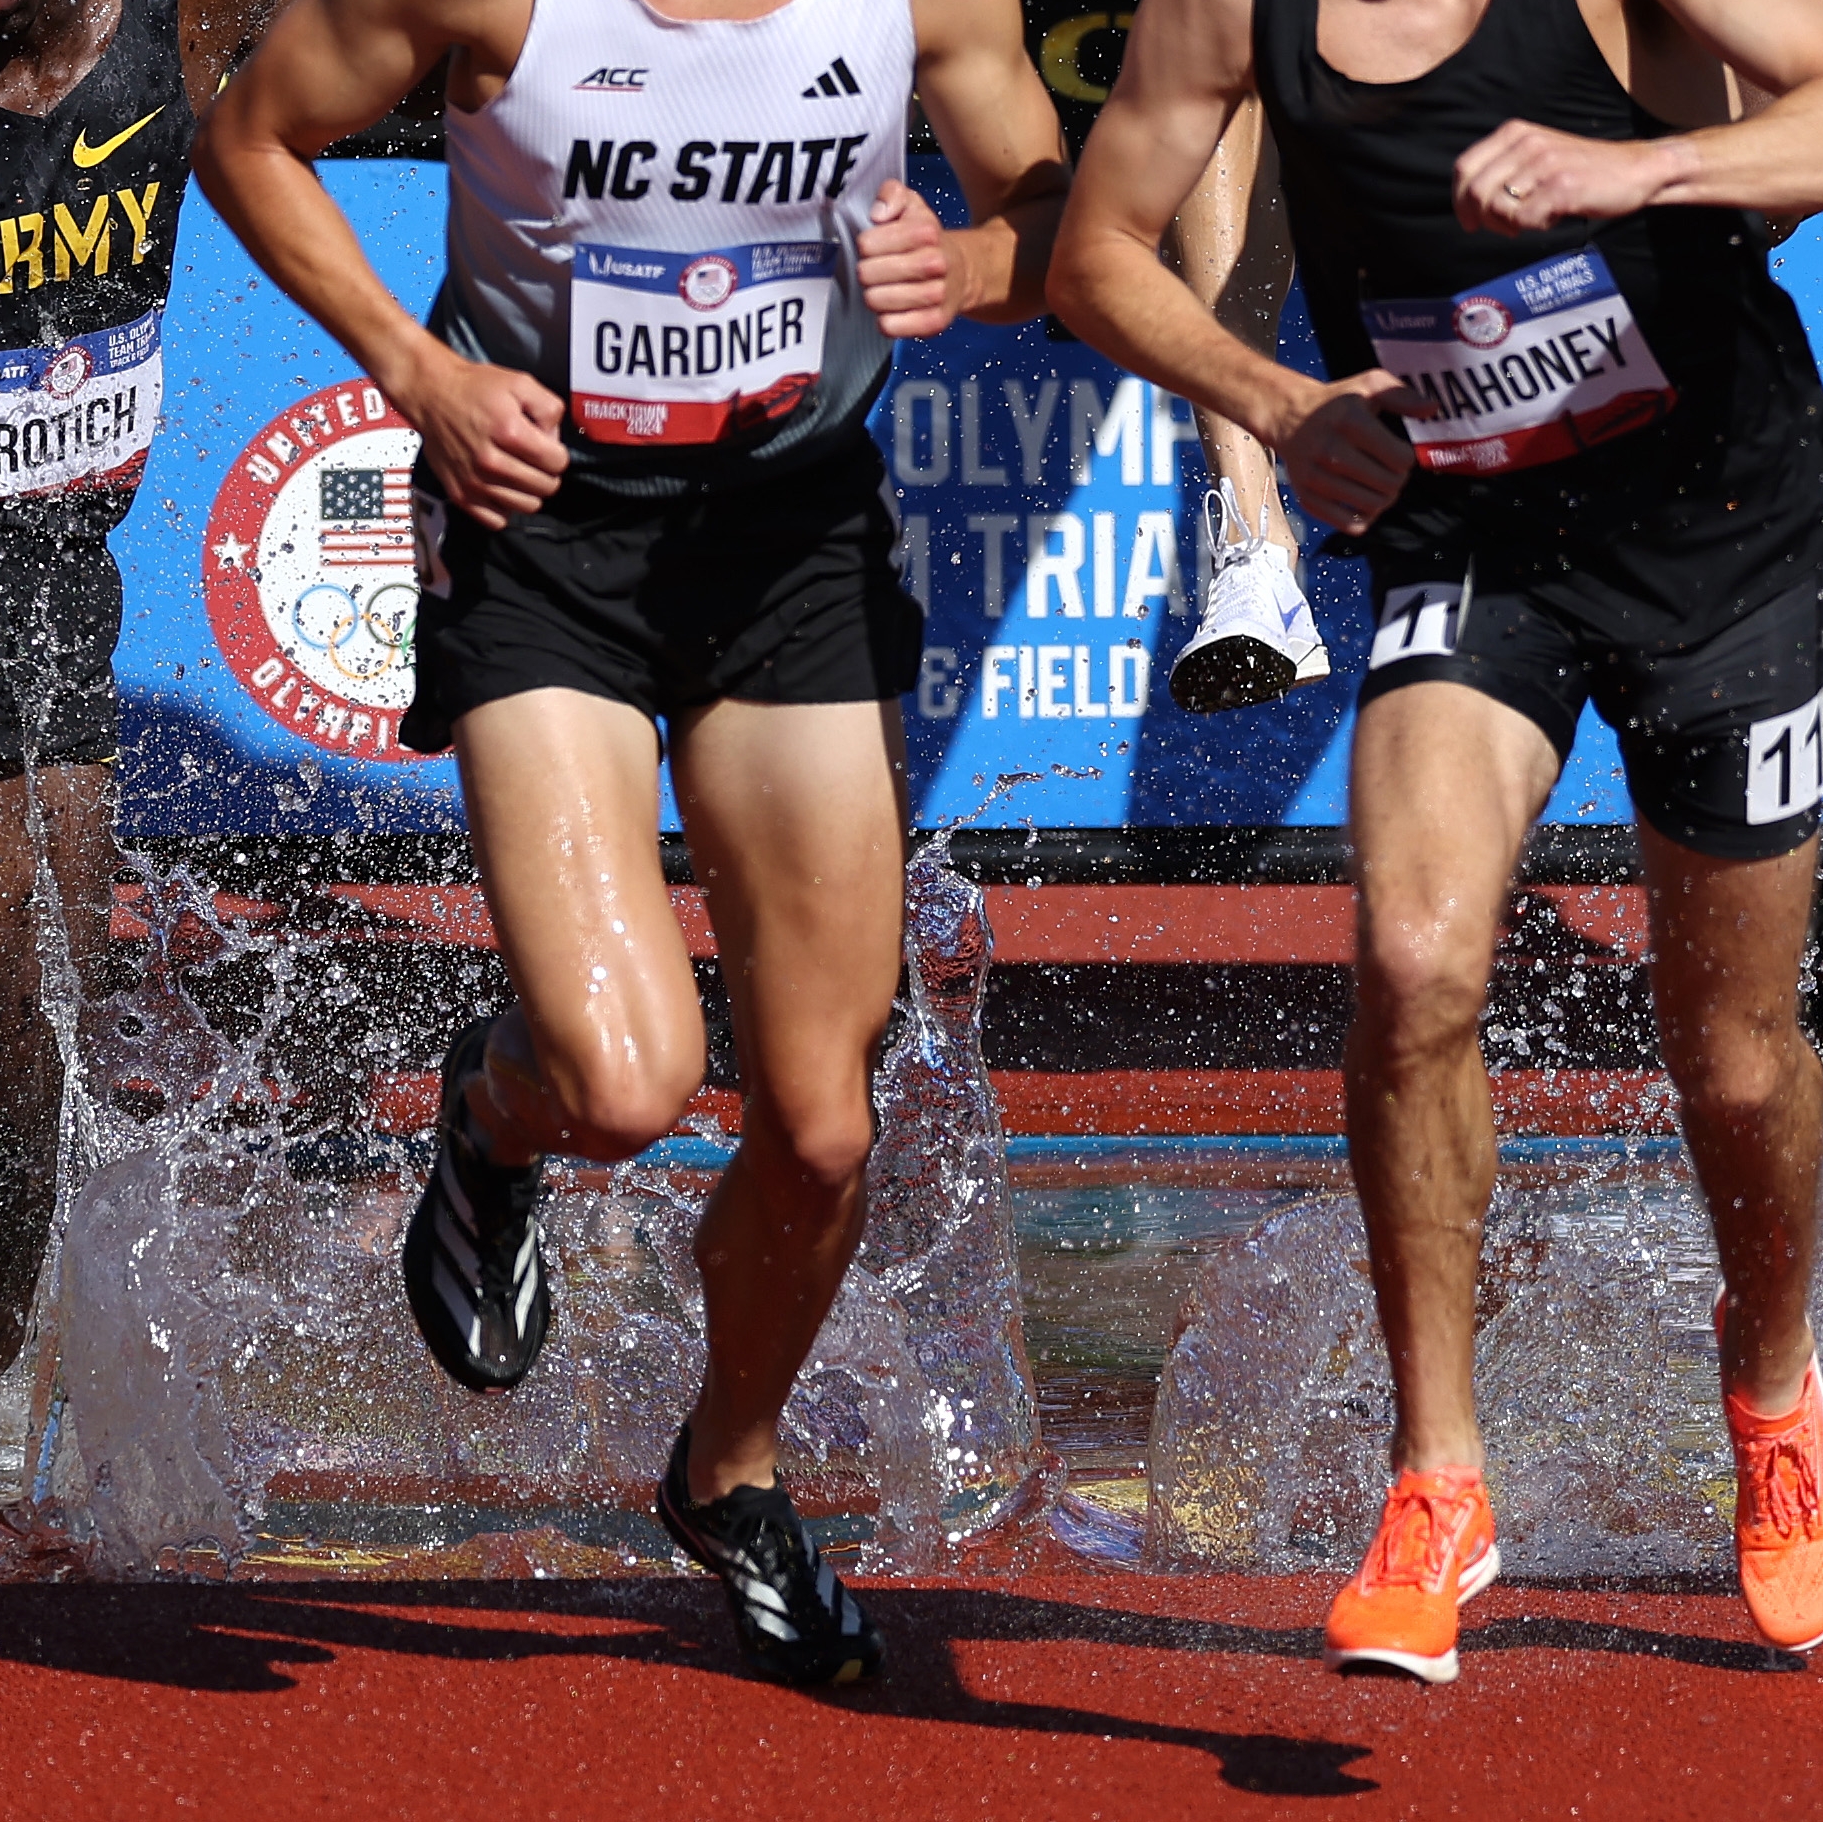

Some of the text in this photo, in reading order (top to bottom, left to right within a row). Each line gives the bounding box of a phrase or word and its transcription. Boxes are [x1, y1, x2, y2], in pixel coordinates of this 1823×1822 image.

[579, 66, 649, 88] ACC
[563, 133, 870, 205] NC STATE
[109, 342, 134, 360] TEAM
[594, 296, 805, 378] GARDNER
[1402, 317, 1628, 425] MAHONEY
[244, 386, 387, 486] UNITED
[892, 377, 1201, 487] OLYMP
[966, 510, 1307, 619] TRIA
[251, 656, 404, 752] OLYMPI
[918, 645, 1151, 718] & FIELD
